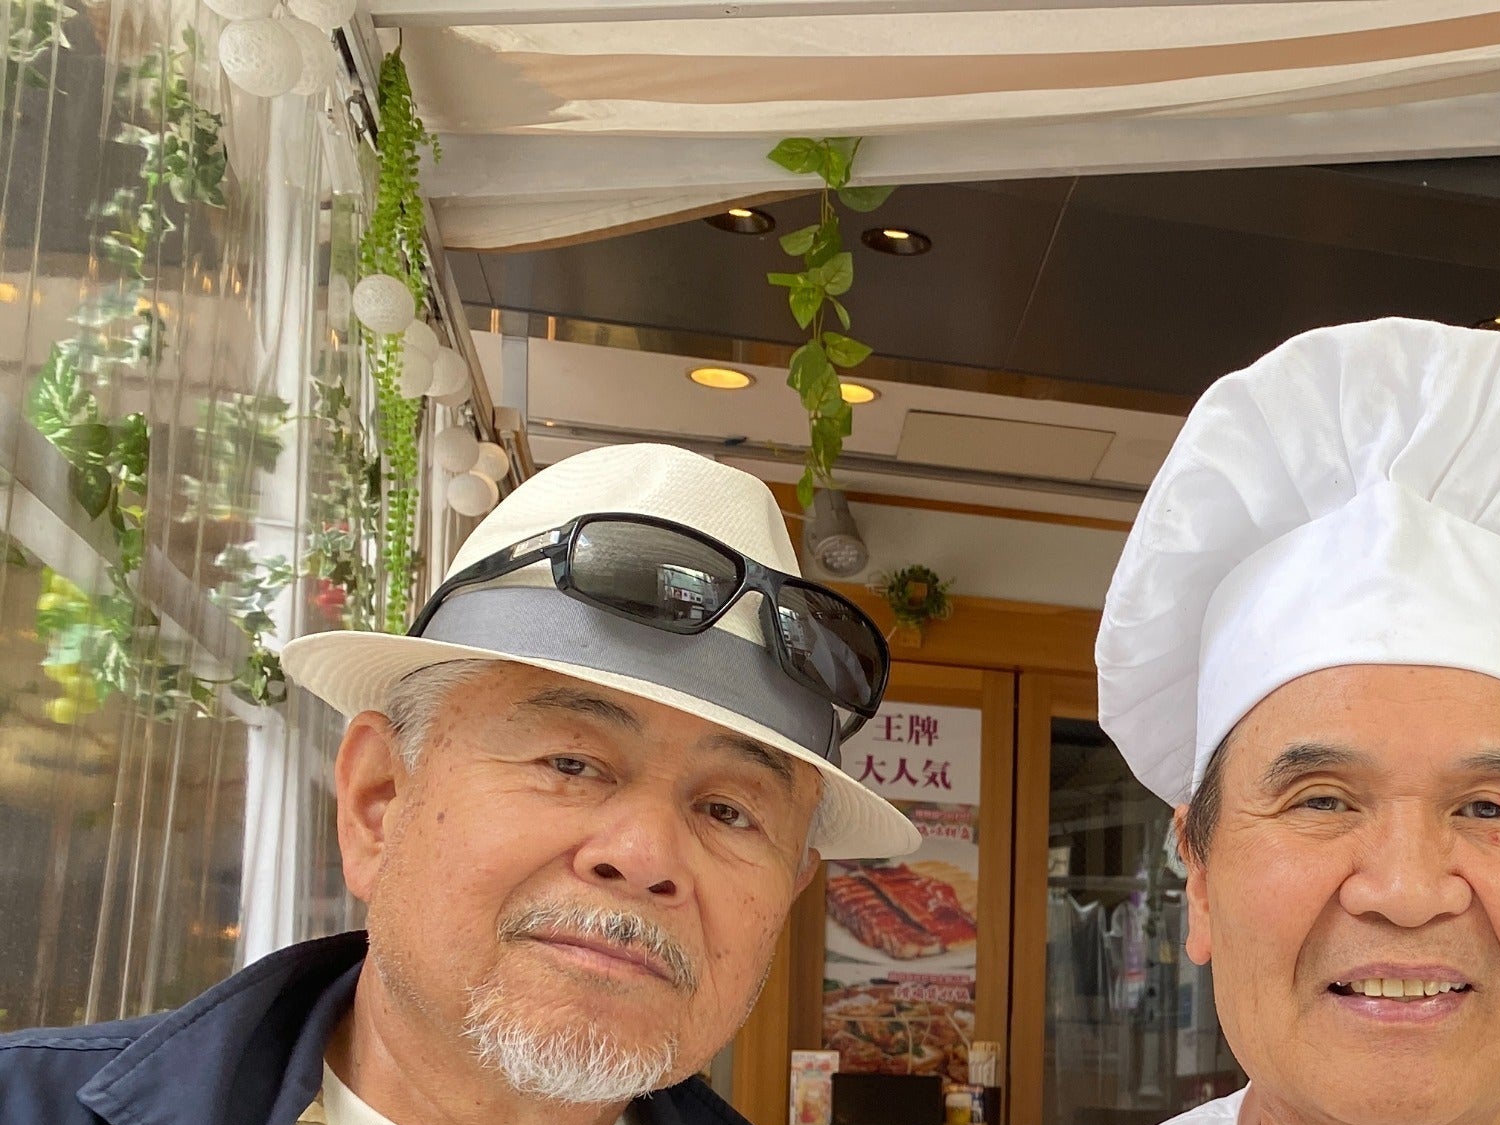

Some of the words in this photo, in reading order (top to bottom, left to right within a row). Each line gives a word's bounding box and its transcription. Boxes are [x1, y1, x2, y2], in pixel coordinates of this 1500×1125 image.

[872, 713, 939, 746] 王牌
[855, 754, 951, 790] 大人気
